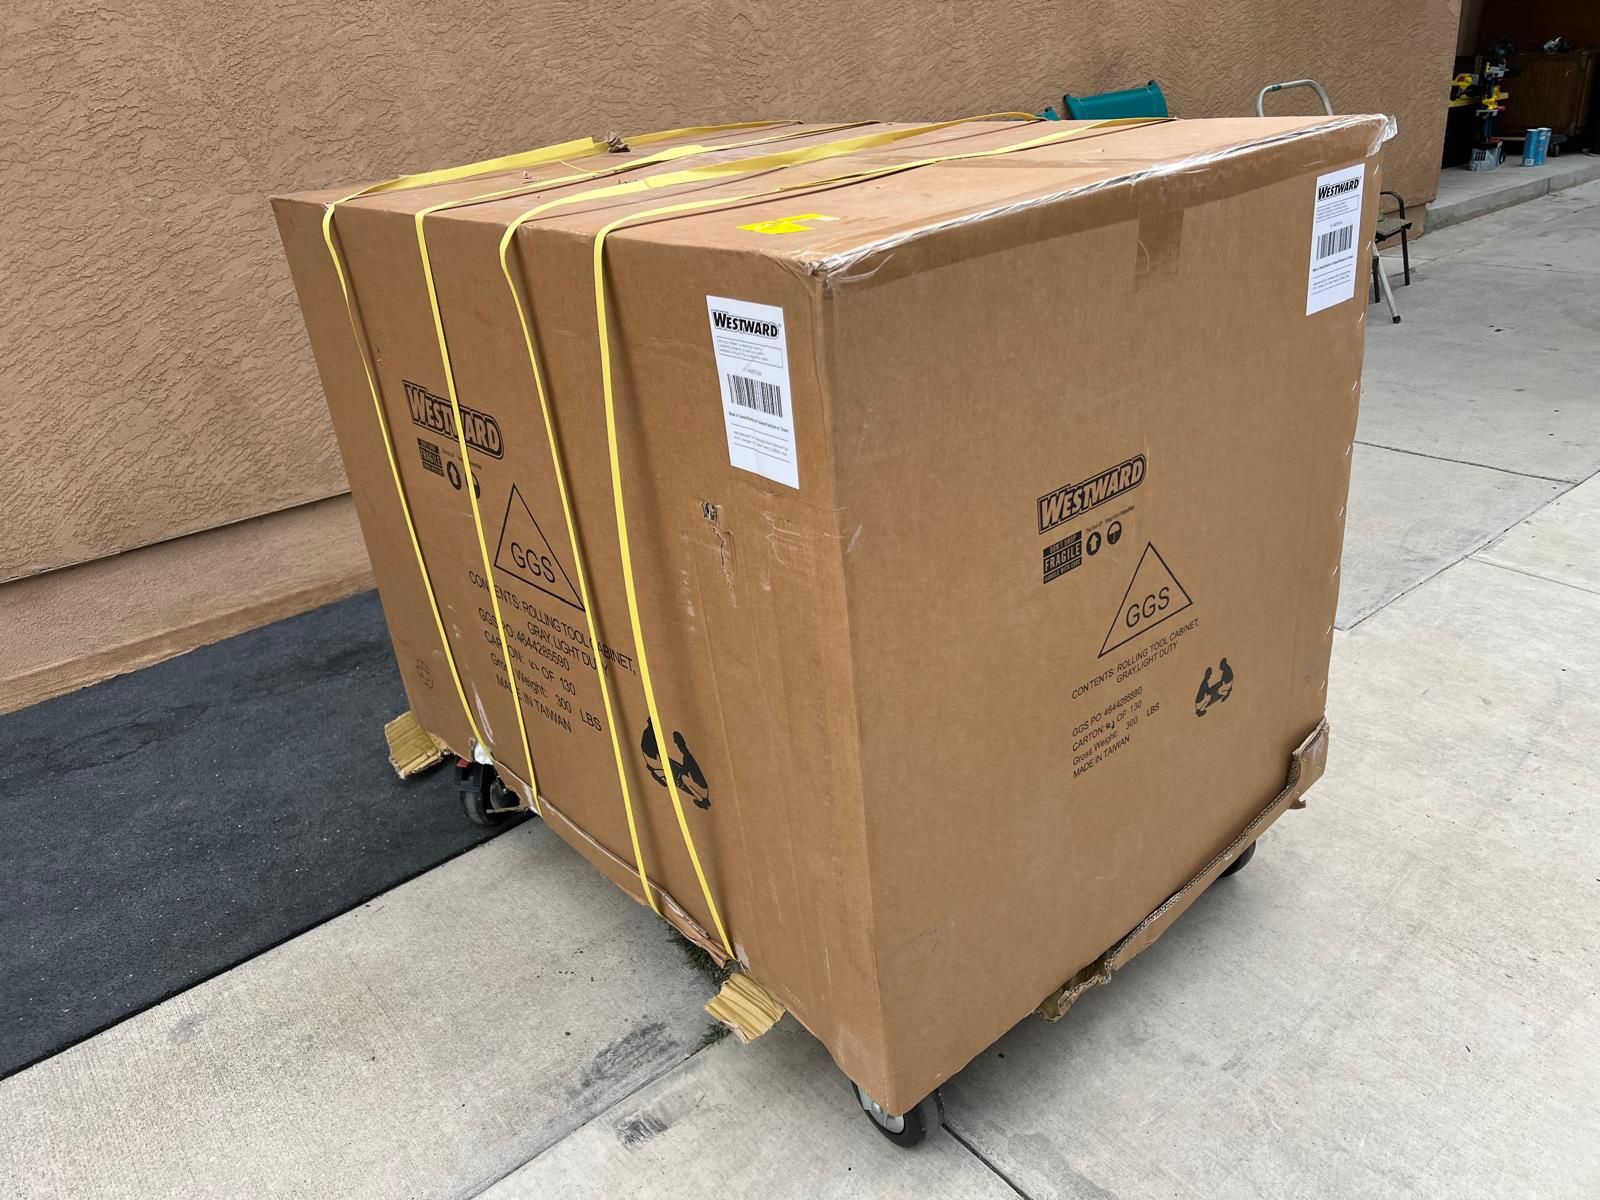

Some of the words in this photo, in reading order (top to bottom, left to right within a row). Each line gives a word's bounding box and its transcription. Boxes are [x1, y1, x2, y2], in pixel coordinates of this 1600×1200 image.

[1318, 178, 1360, 201] WESTWARD
[712, 310, 779, 339] WESTWARD
[1039, 455, 1145, 533] WESTWARD
[511, 542, 555, 583] GGS
[1044, 543, 1081, 572] FRAGILE
[469, 571, 522, 611] CONENTS:
[522, 601, 562, 633] ROLLING
[561, 622, 590, 649] TOOL
[1126, 586, 1170, 628] GGS
[484, 631, 524, 664] CARON:
[541, 666, 555, 682] OF
[559, 676, 576, 696] 130
[581, 651, 608, 677] DUY
[1071, 667, 1116, 700] CONTENTS:
[1117, 647, 1149, 673] ROLLING
[1149, 636, 1169, 652] TOOL
[1159, 640, 1179, 659] DUTY
[496, 673, 522, 700] MAE
[523, 692, 534, 708] IN
[534, 699, 572, 733] TAIWAN
[580, 708, 602, 732] LBS
[1116, 709, 1128, 722] OF
[1072, 720, 1089, 737] GGS
[1072, 748, 1093, 766] Gross
[1125, 715, 1139, 731] 300
[1146, 702, 1160, 717] LBS
[1072, 758, 1094, 778] MADE
[1094, 753, 1103, 766] IN
[1103, 734, 1131, 758] TAIWAN
